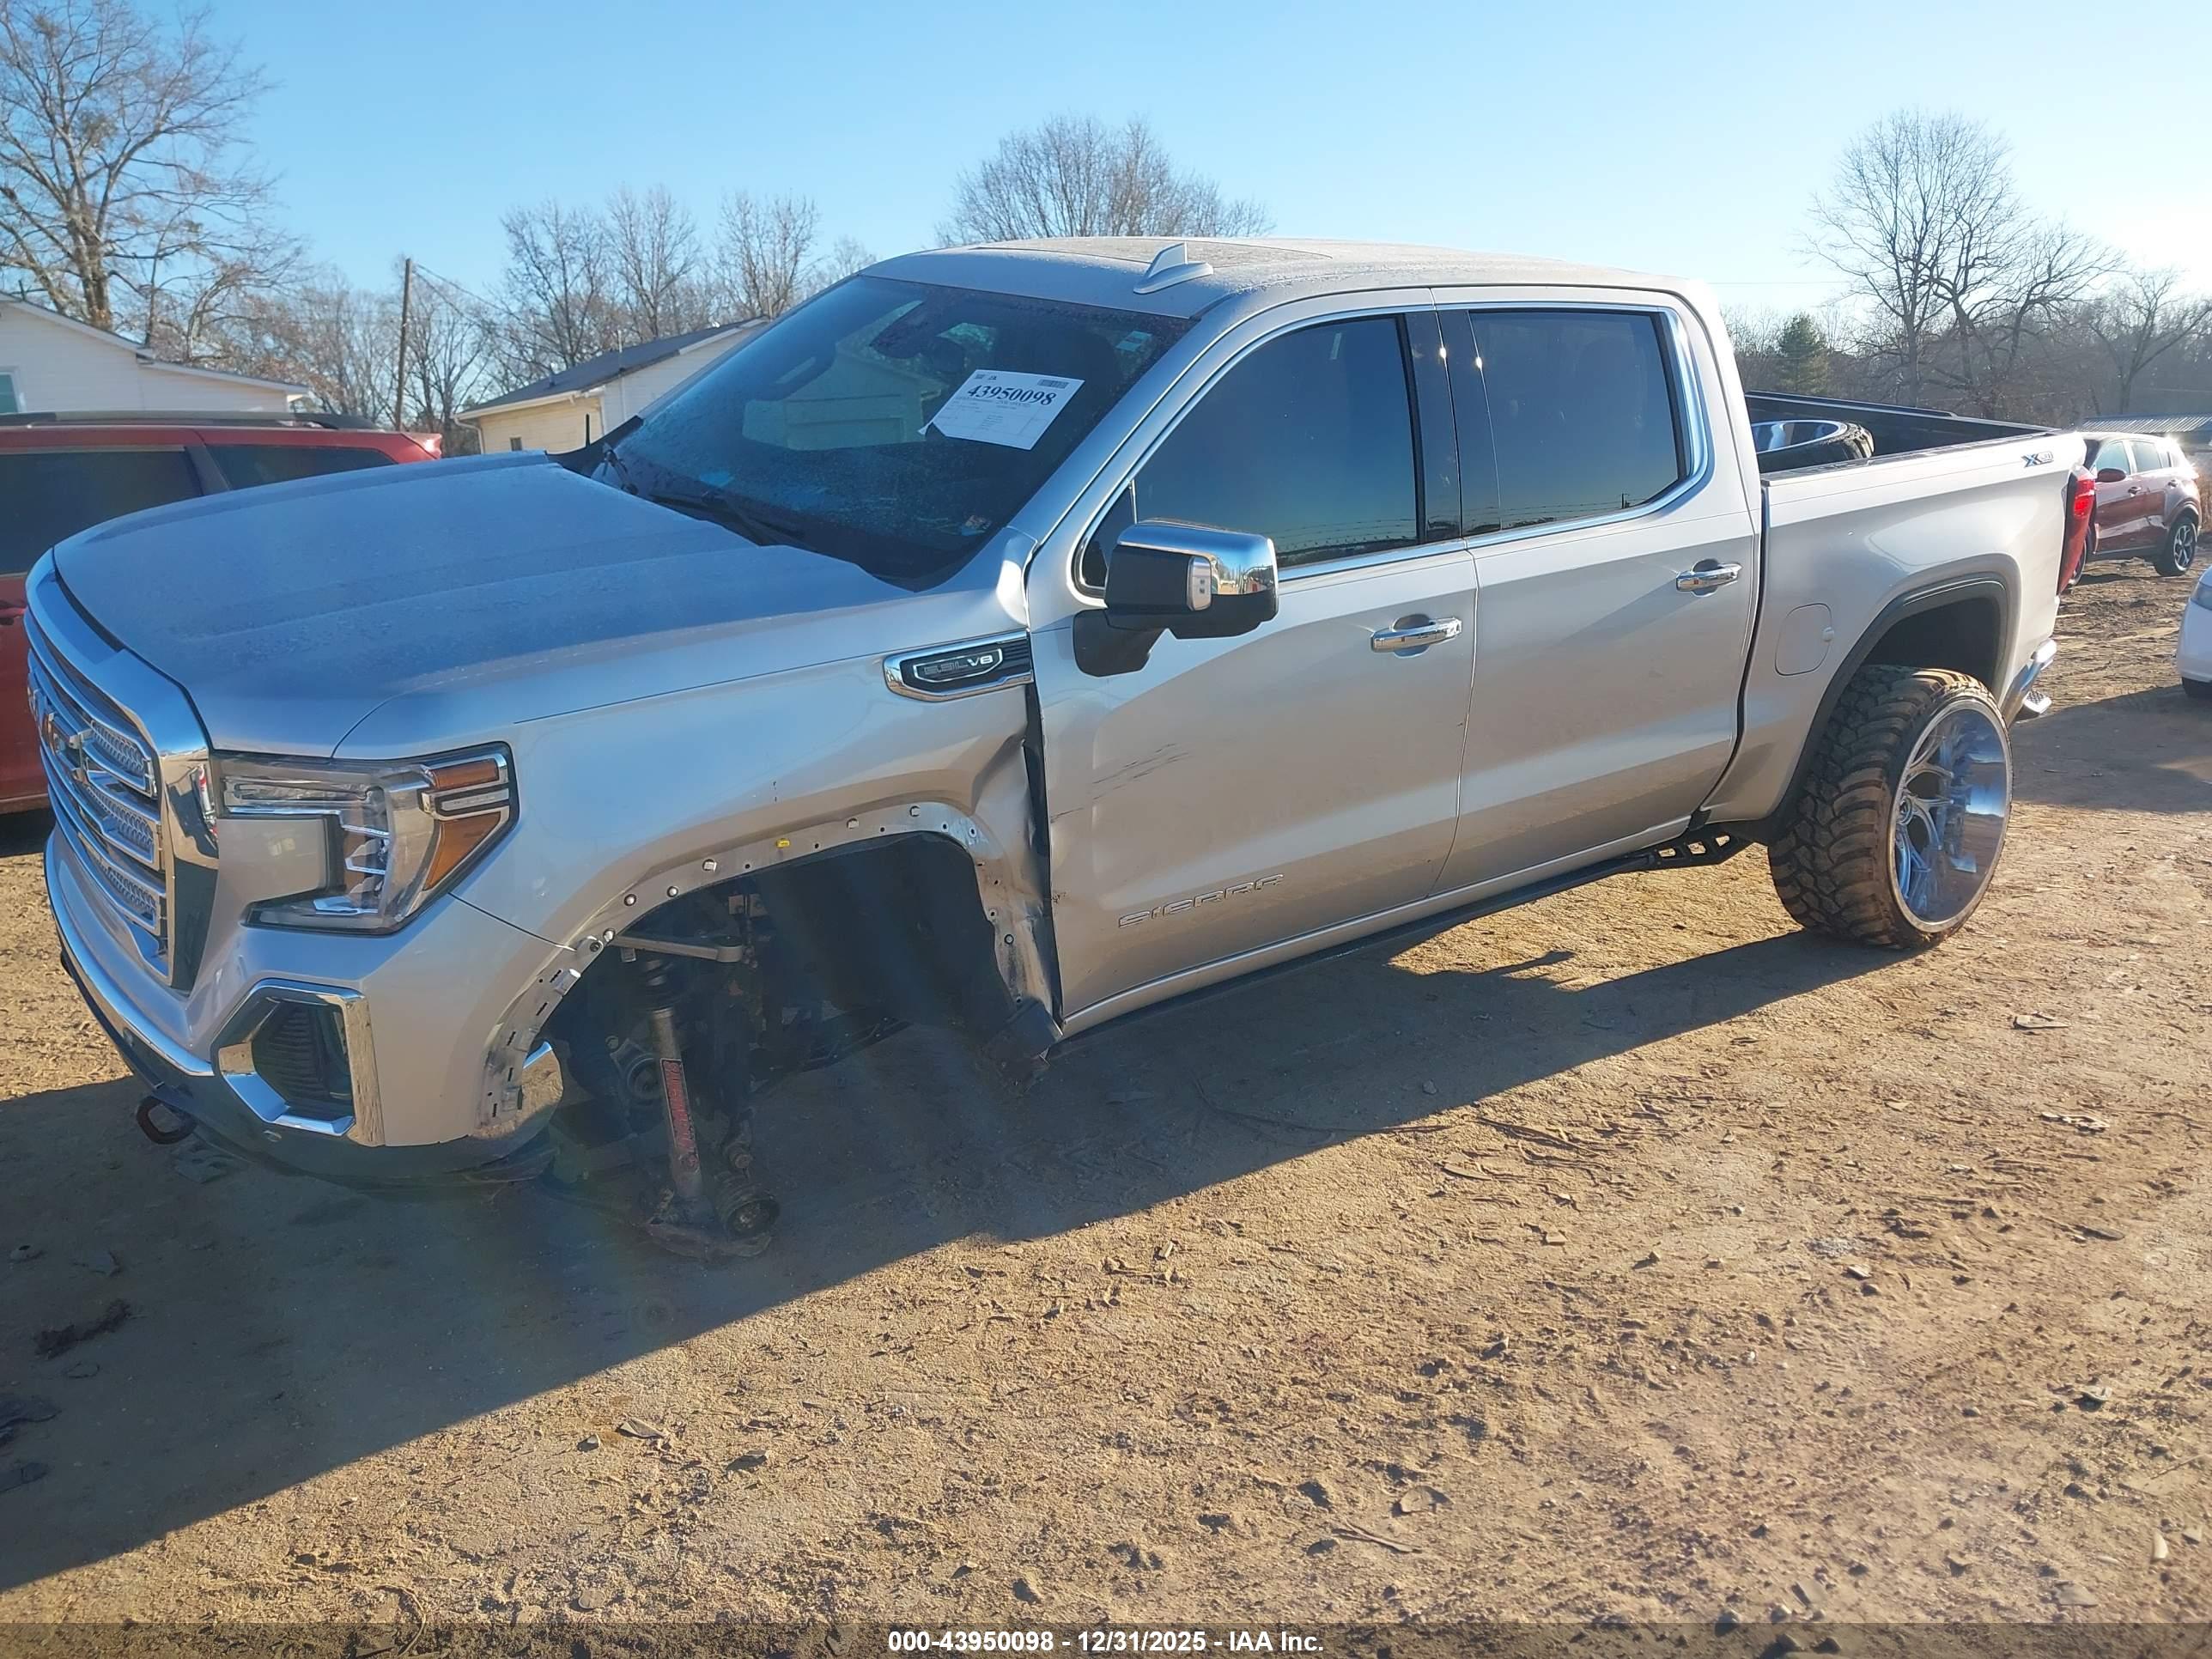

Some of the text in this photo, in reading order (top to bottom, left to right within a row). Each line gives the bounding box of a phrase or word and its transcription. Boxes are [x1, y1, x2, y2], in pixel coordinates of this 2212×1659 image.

[967, 385, 1057, 406] 43950098
[967, 654, 994, 667] V8
[1118, 873, 1284, 928] SIERRA
